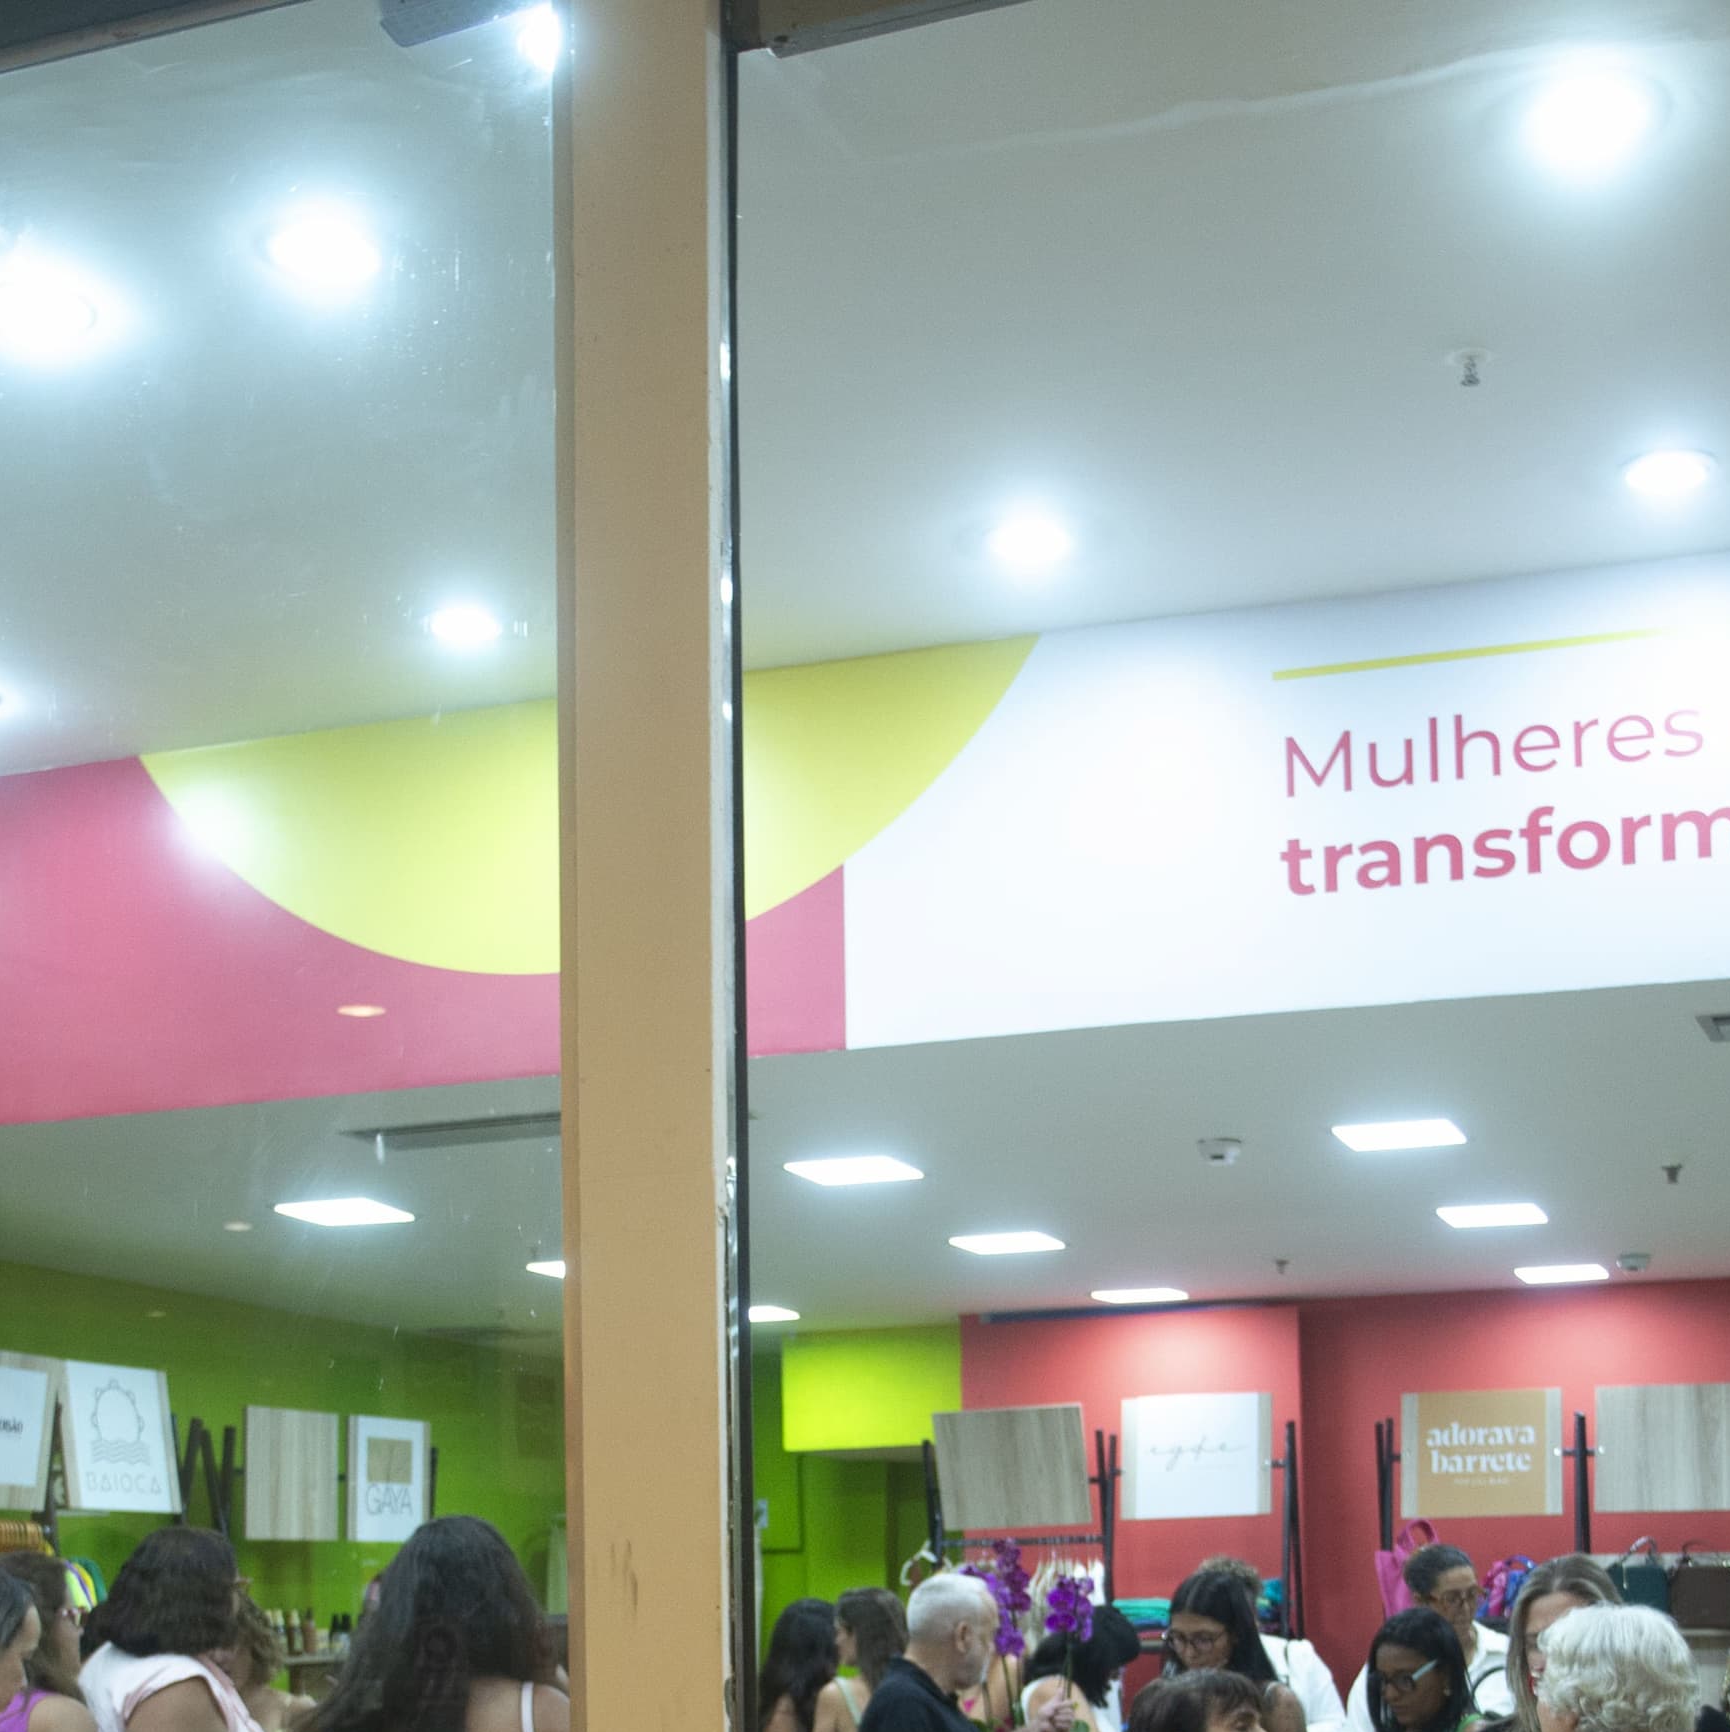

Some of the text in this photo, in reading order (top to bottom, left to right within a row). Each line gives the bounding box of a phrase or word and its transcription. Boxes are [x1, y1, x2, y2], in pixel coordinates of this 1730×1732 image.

[1284, 708, 1704, 798] Mulheres
[1425, 1420, 1536, 1449] adorava
[85, 1471, 162, 1496] BAIOCA
[366, 1482, 414, 1517] GAYA
